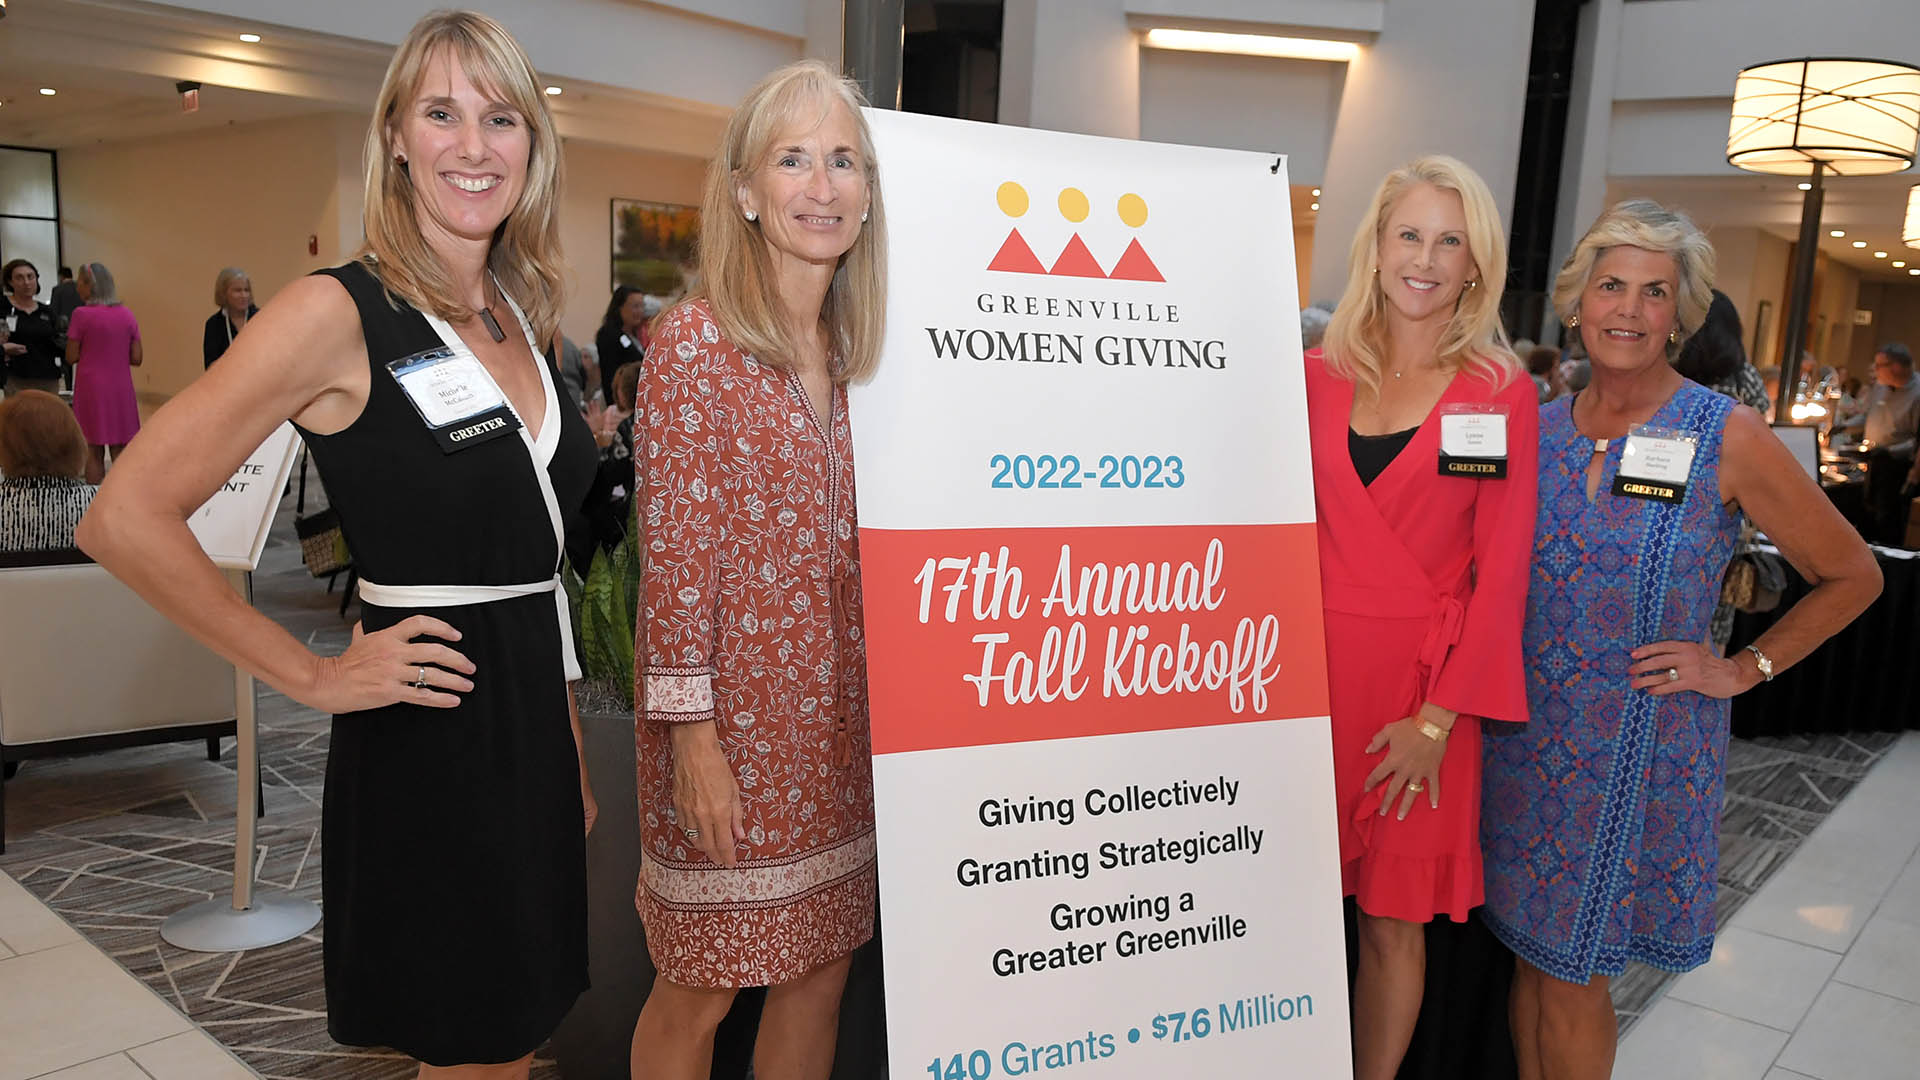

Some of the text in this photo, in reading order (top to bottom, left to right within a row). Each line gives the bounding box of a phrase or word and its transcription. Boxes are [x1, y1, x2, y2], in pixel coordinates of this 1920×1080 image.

[977, 293, 1180, 323] GREENVILLE
[925, 327, 1227, 370] WOMEN GIVING
[449, 416, 507, 442] GREETER
[990, 454, 1185, 489] 2022-2023
[1448, 462, 1497, 473] GREETER
[1623, 483, 1674, 498] GREETER
[913, 537, 1226, 624] 17th Annual
[962, 614, 1281, 714] Fall Kickoff
[978, 775, 1240, 828] Giving Collectively
[956, 825, 1264, 887] Granting Strategically
[1049, 892, 1195, 931] Growing a
[992, 914, 1247, 977] Greater Greenville
[927, 993, 1314, 1080] 140 Grants $7.6 Million
